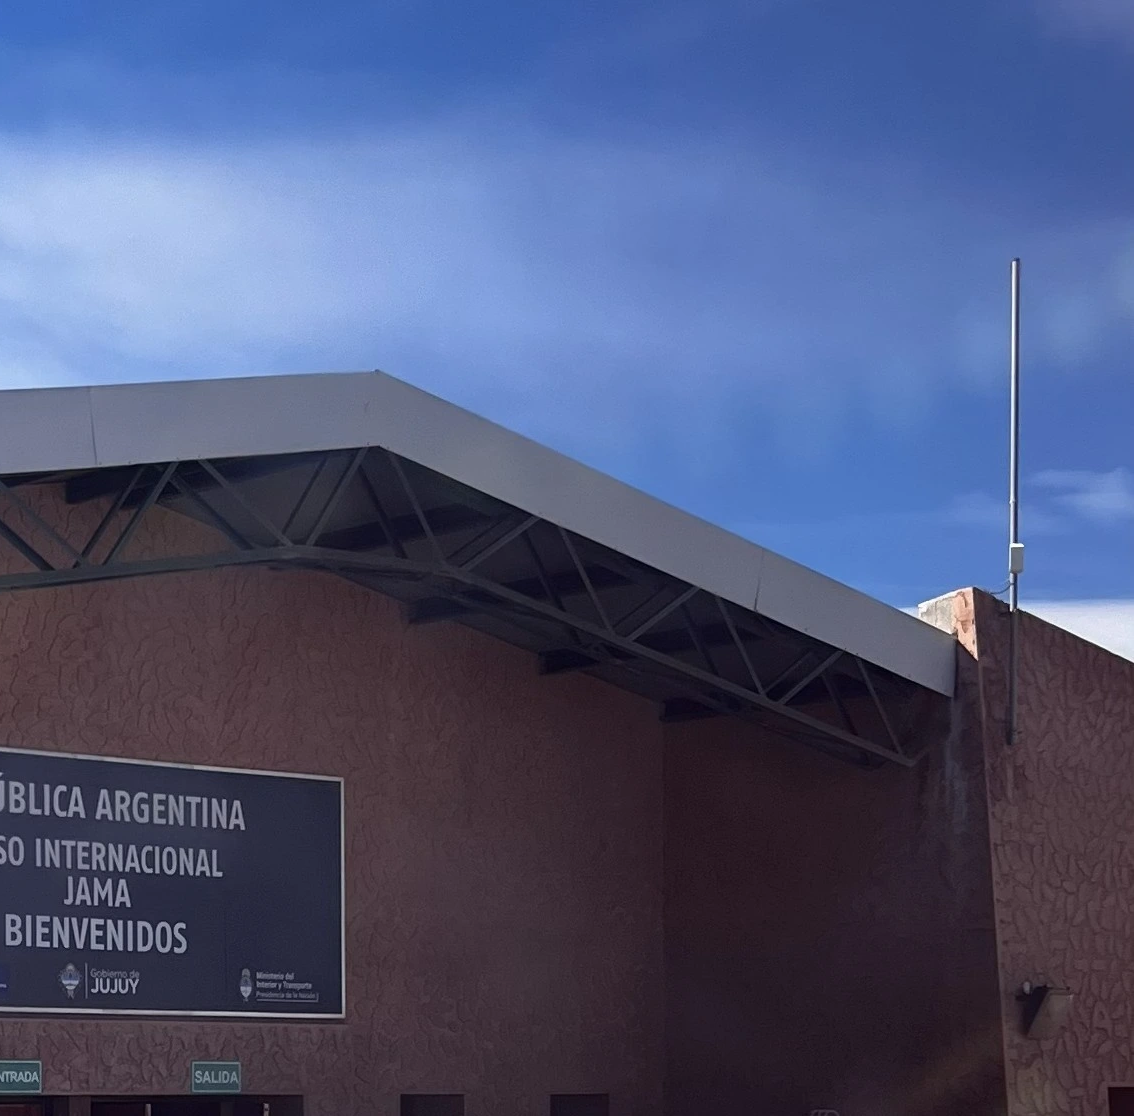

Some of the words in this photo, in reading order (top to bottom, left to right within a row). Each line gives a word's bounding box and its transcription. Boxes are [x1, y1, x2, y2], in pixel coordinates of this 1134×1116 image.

[95, 788, 246, 831] ARGENTINA
[35, 838, 223, 878] INTERNACIONAL
[63, 876, 132, 908] JAMA
[5, 913, 188, 954] BIENVENIDOS
[90, 968, 128, 979] Gobierno
[129, 969, 140, 979] de
[90, 978, 140, 995] JUJUY
[194, 1070, 239, 1084] SALIDA
